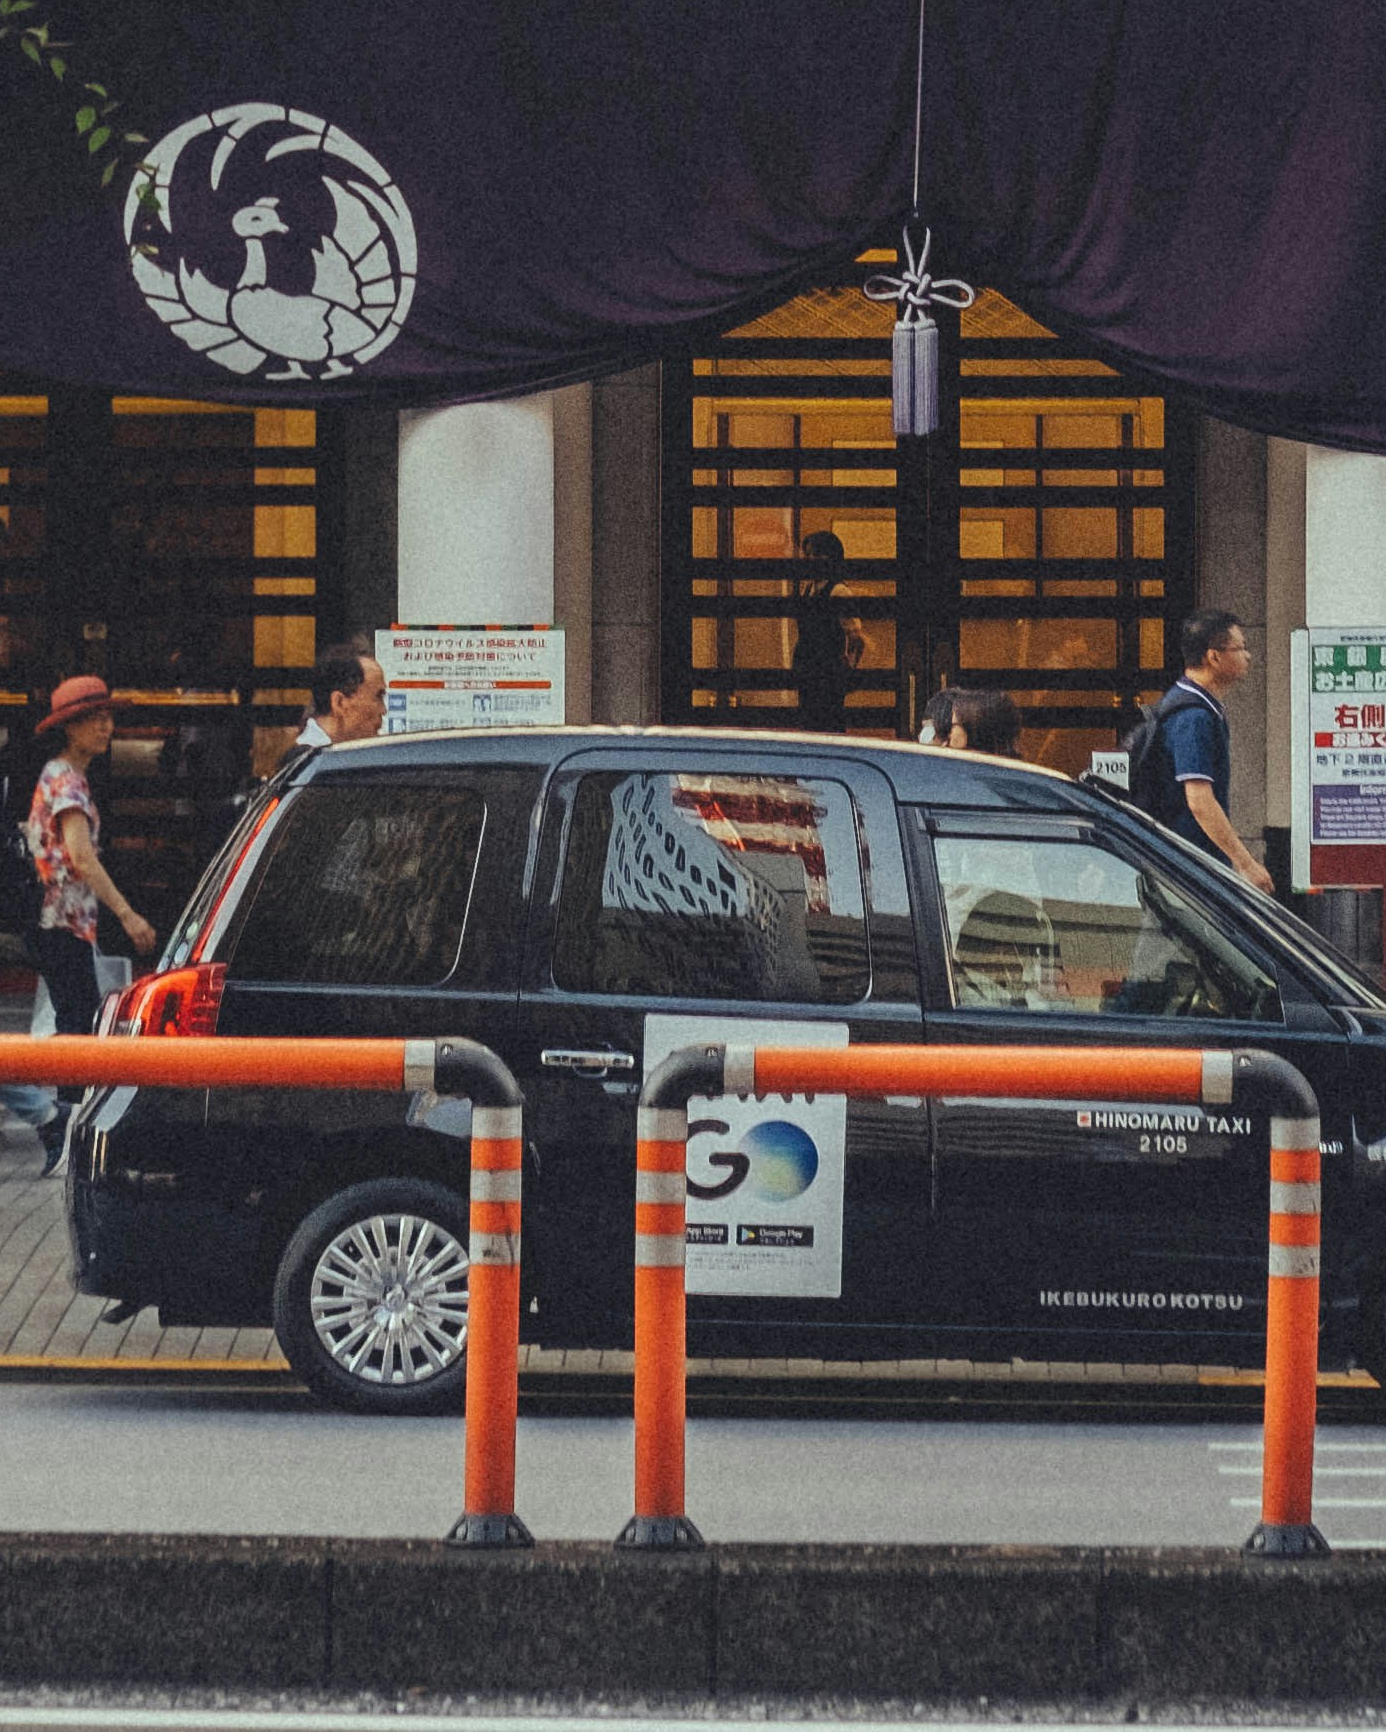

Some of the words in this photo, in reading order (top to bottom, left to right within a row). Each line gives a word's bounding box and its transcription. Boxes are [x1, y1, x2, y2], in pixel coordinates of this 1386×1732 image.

[1096, 761, 1127, 774] 2105
[1094, 1112, 1199, 1133] HINOMARU
[1206, 1116, 1252, 1135] TAXI
[1139, 1136, 1188, 1154] 2105
[1039, 1290, 1166, 1308] IKEBUKURO
[1170, 1293, 1244, 1311] KOTSU
